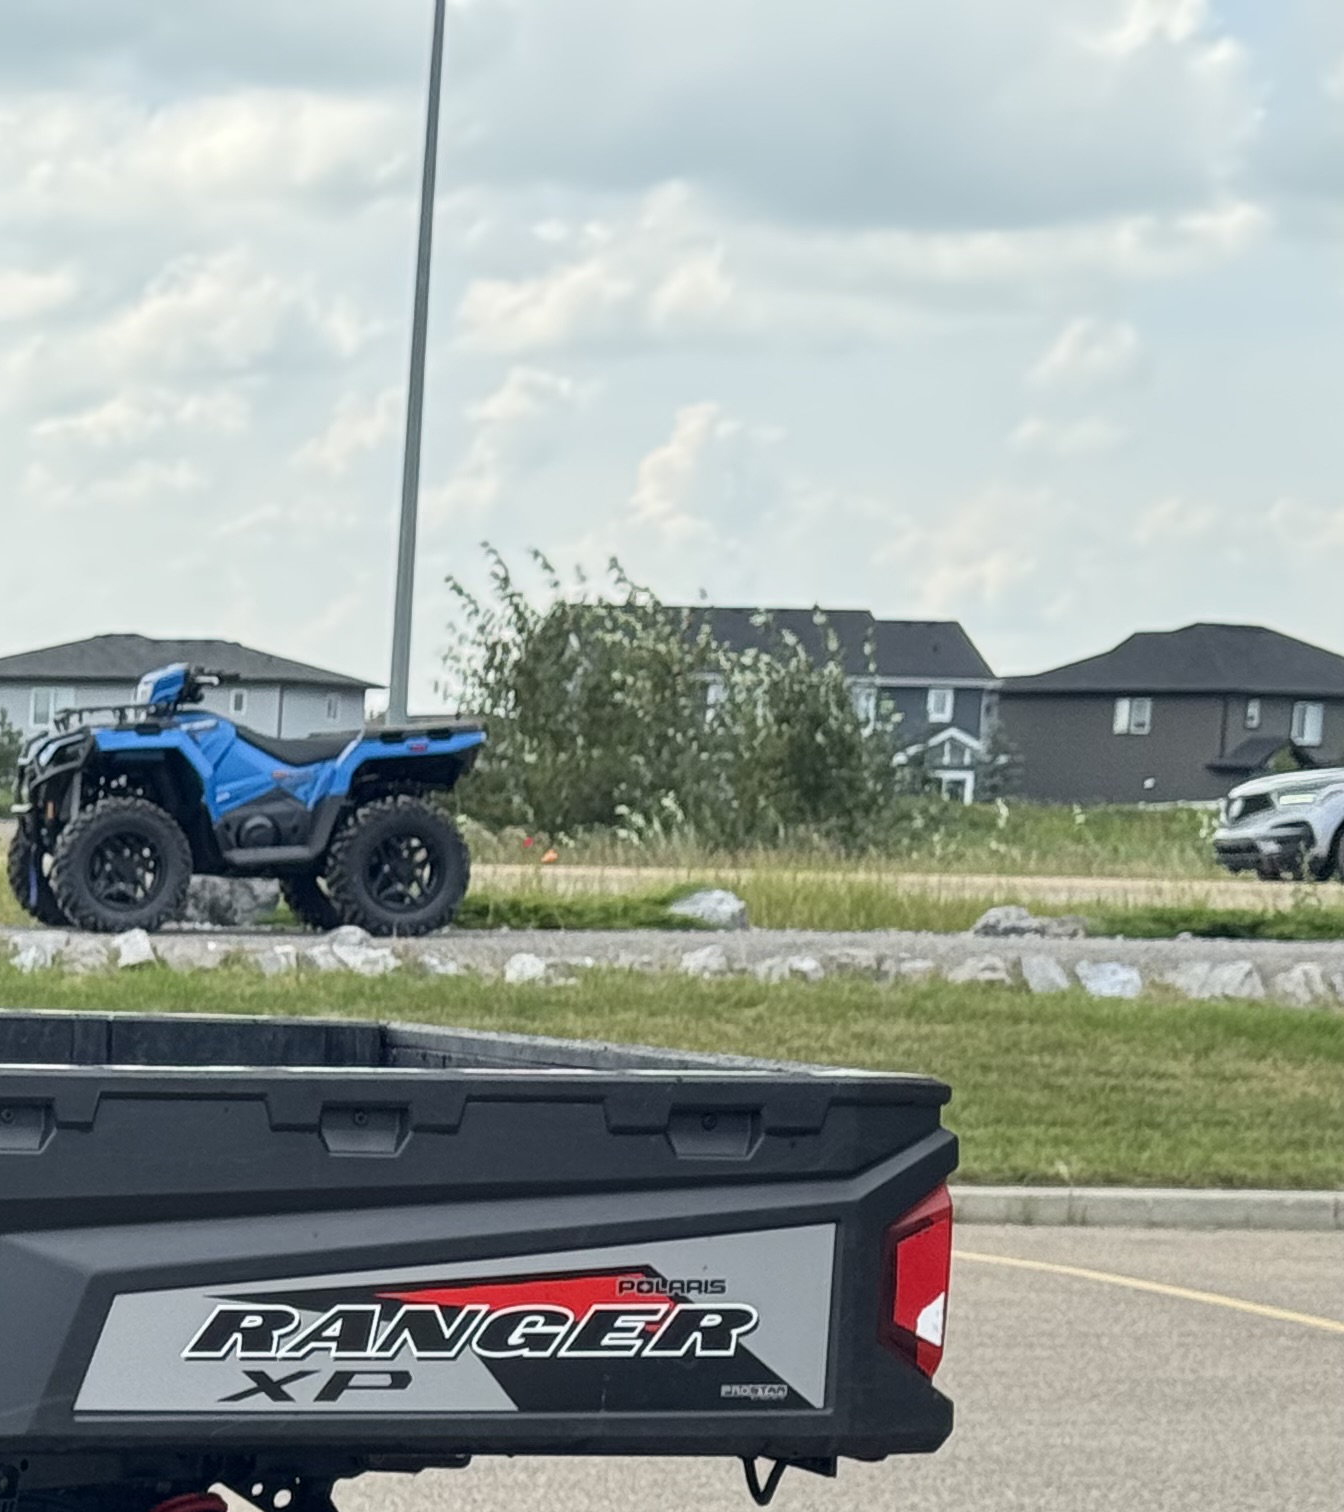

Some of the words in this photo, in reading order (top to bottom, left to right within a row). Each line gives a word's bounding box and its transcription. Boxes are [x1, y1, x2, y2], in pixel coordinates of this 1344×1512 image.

[617, 1279, 727, 1295] POLARIS
[180, 1302, 760, 1360] RANGER
[218, 1368, 414, 1403] XP
